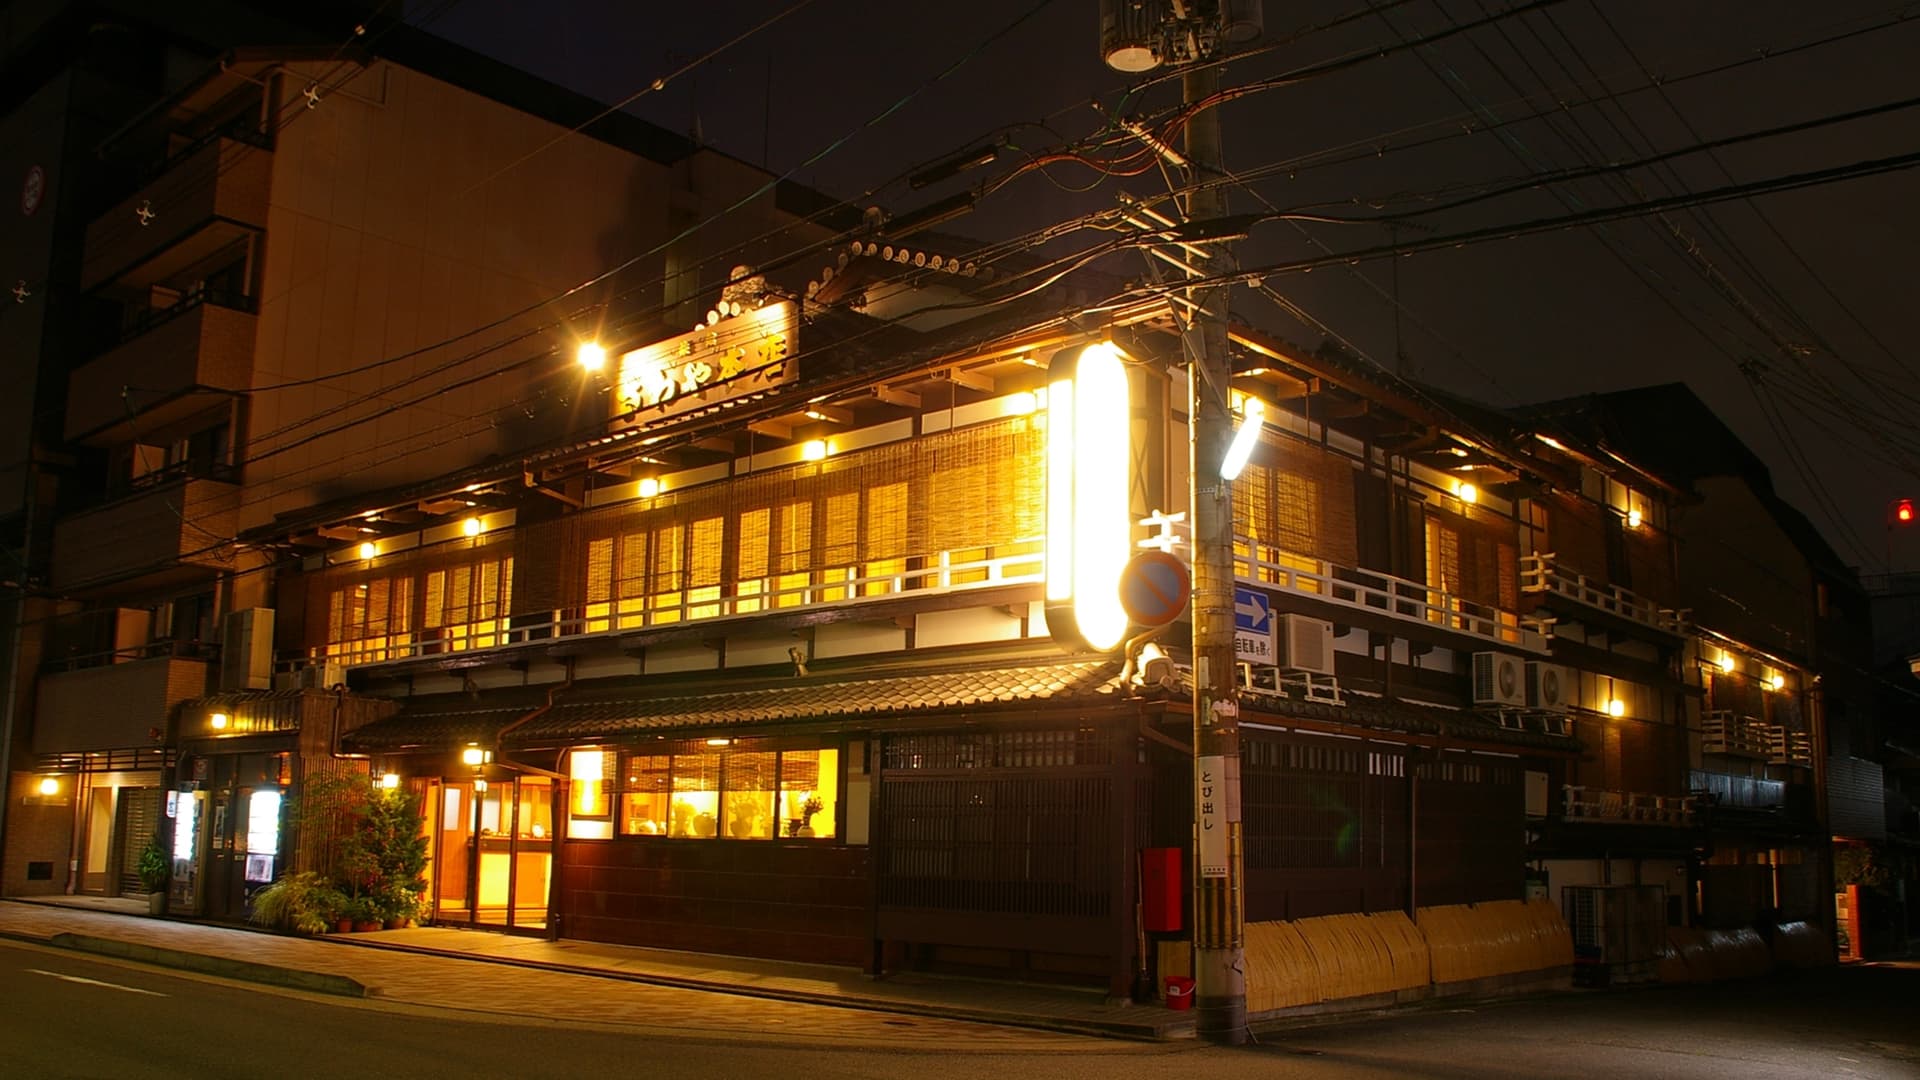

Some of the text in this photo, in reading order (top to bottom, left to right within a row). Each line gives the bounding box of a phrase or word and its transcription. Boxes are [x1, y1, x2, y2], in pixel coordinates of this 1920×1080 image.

[1235, 638, 1270, 656] 自転車を除く
[1202, 771, 1213, 830] とび出し
